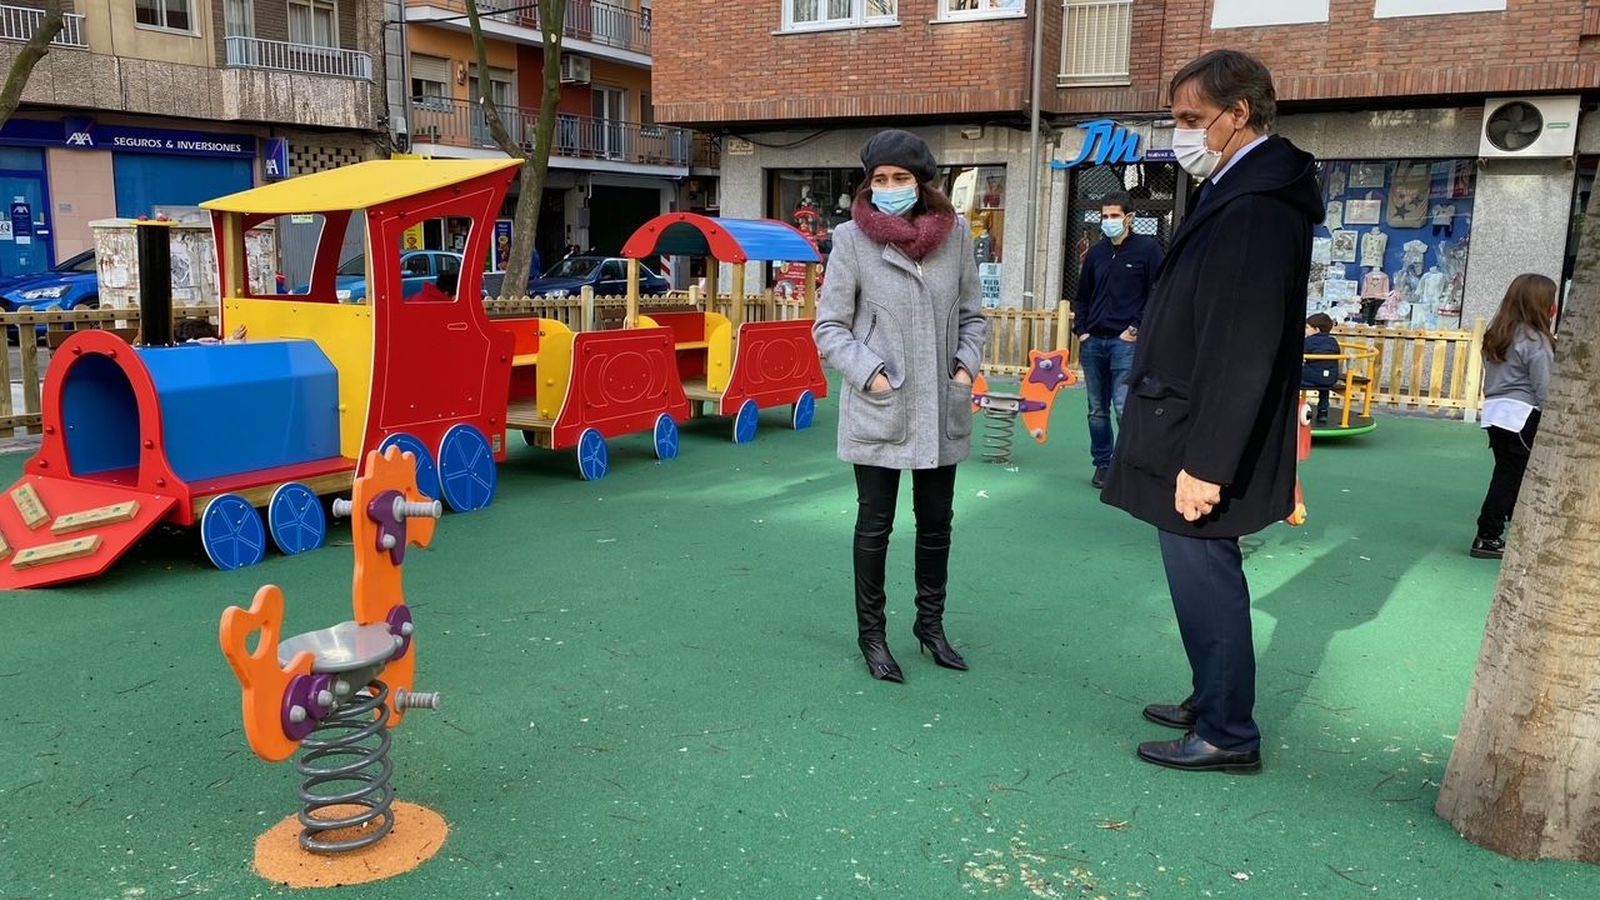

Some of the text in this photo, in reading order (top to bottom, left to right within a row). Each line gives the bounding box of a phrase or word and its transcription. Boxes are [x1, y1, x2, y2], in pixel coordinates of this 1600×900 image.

[66, 132, 94, 146] AXA
[113, 136, 242, 153] SEGUROS & INVERSIONES
